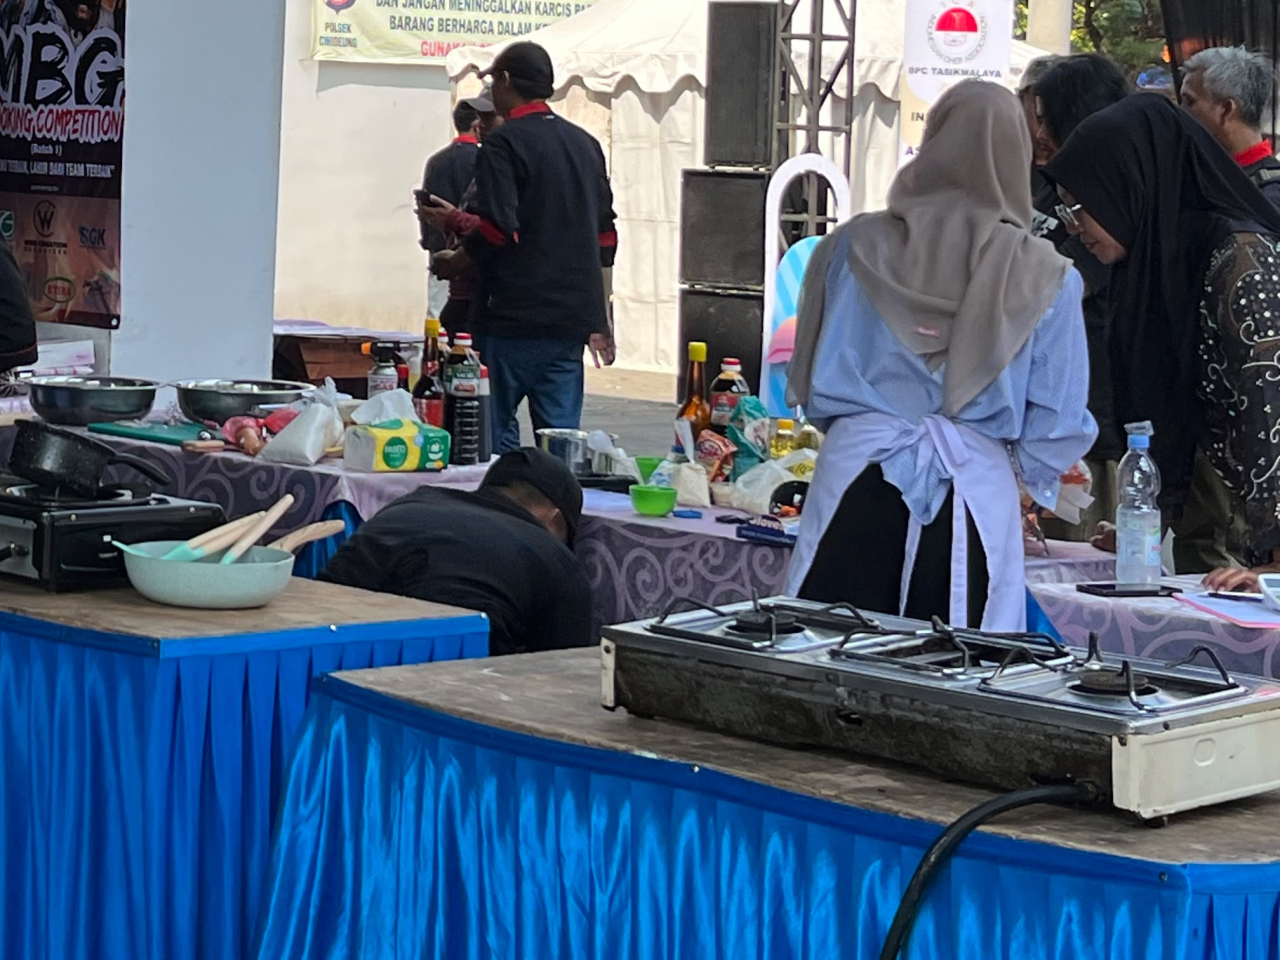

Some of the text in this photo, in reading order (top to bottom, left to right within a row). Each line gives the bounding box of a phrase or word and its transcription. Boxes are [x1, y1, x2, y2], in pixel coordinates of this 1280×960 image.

[535, 0, 572, 17] KARCIS
[325, 22, 351, 33] POLSEK
[389, 15, 434, 33] BARANG
[438, 17, 494, 36] BERHARGA
[498, 20, 532, 36] DALAM
[931, 67, 1002, 78] TASIKMALAYA
[35, 106, 121, 139] COMPETITION
[30, 143, 54, 156] (Batch
[65, 163, 85, 177] TEAM
[78, 226, 107, 246] SGK
